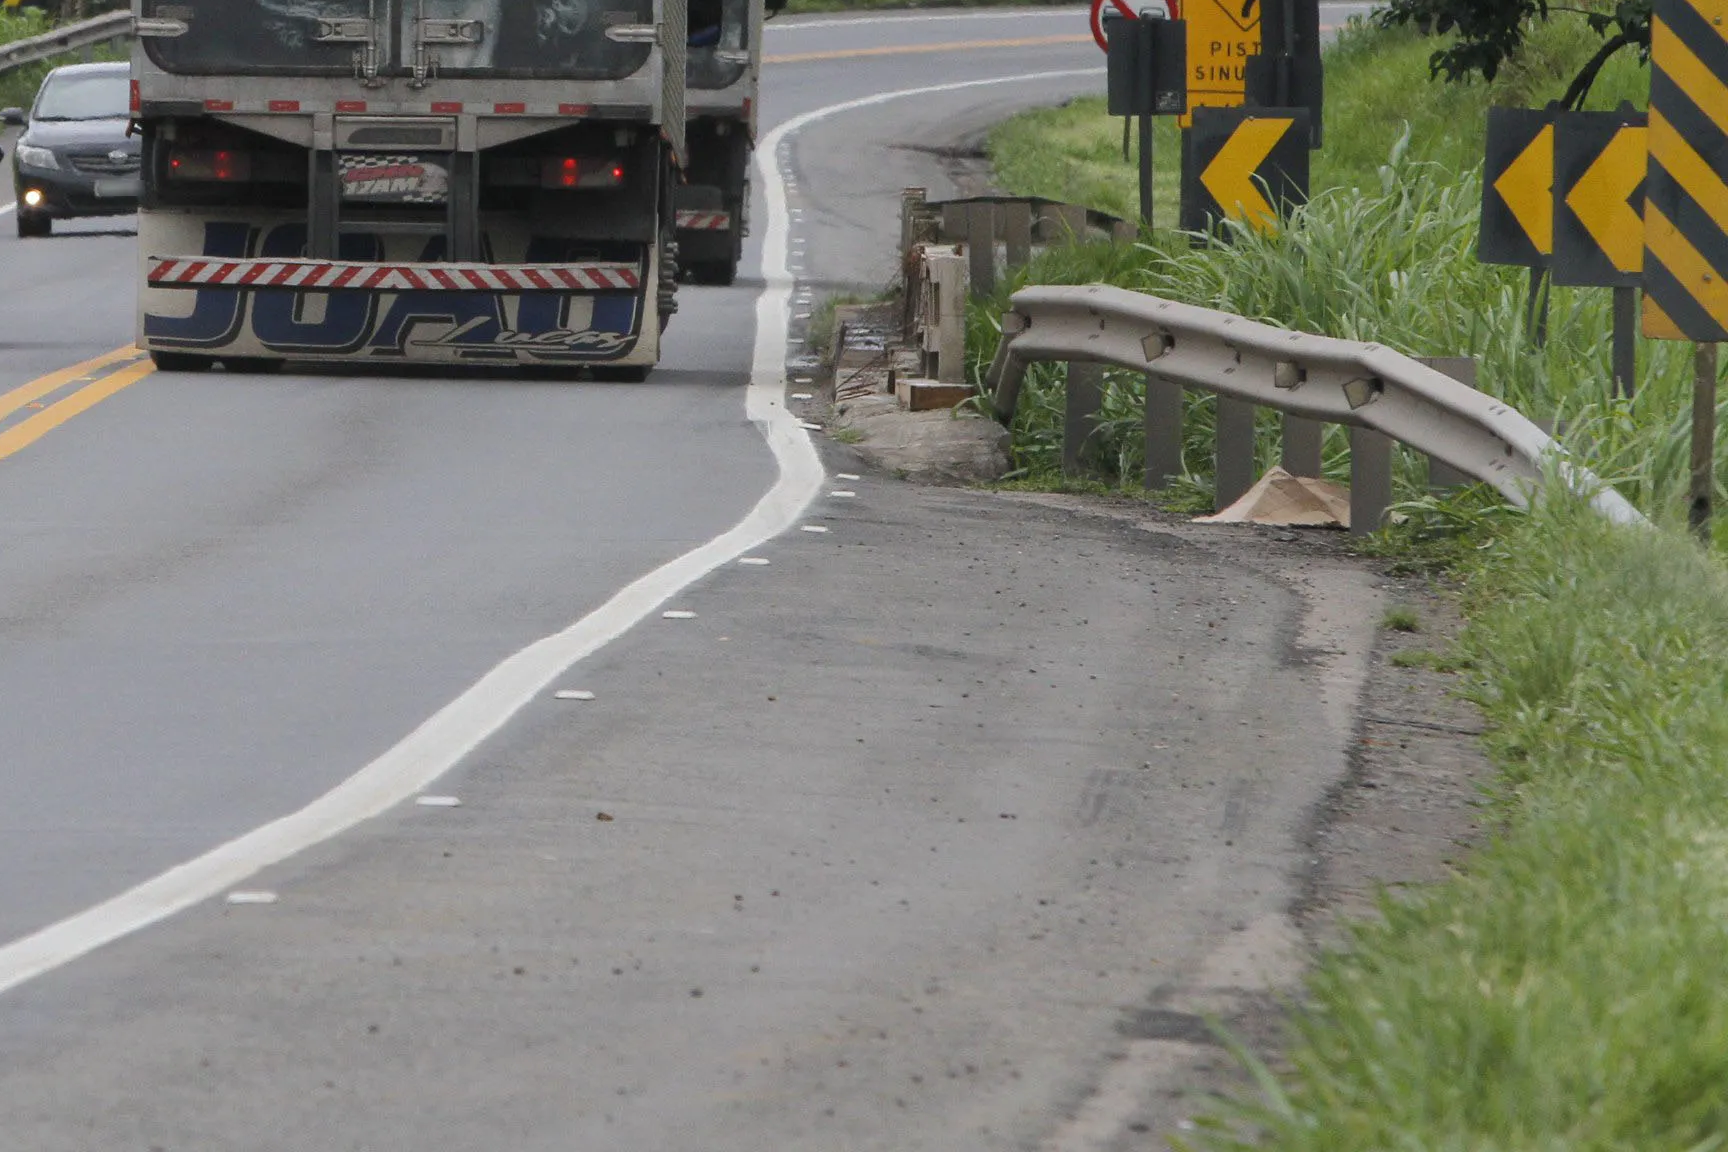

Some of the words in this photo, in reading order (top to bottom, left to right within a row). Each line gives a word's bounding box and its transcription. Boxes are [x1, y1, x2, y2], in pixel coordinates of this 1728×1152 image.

[1210, 41, 1262, 57] PIST
[1195, 65, 1246, 81] SINU
[410, 315, 637, 350] Lucas
